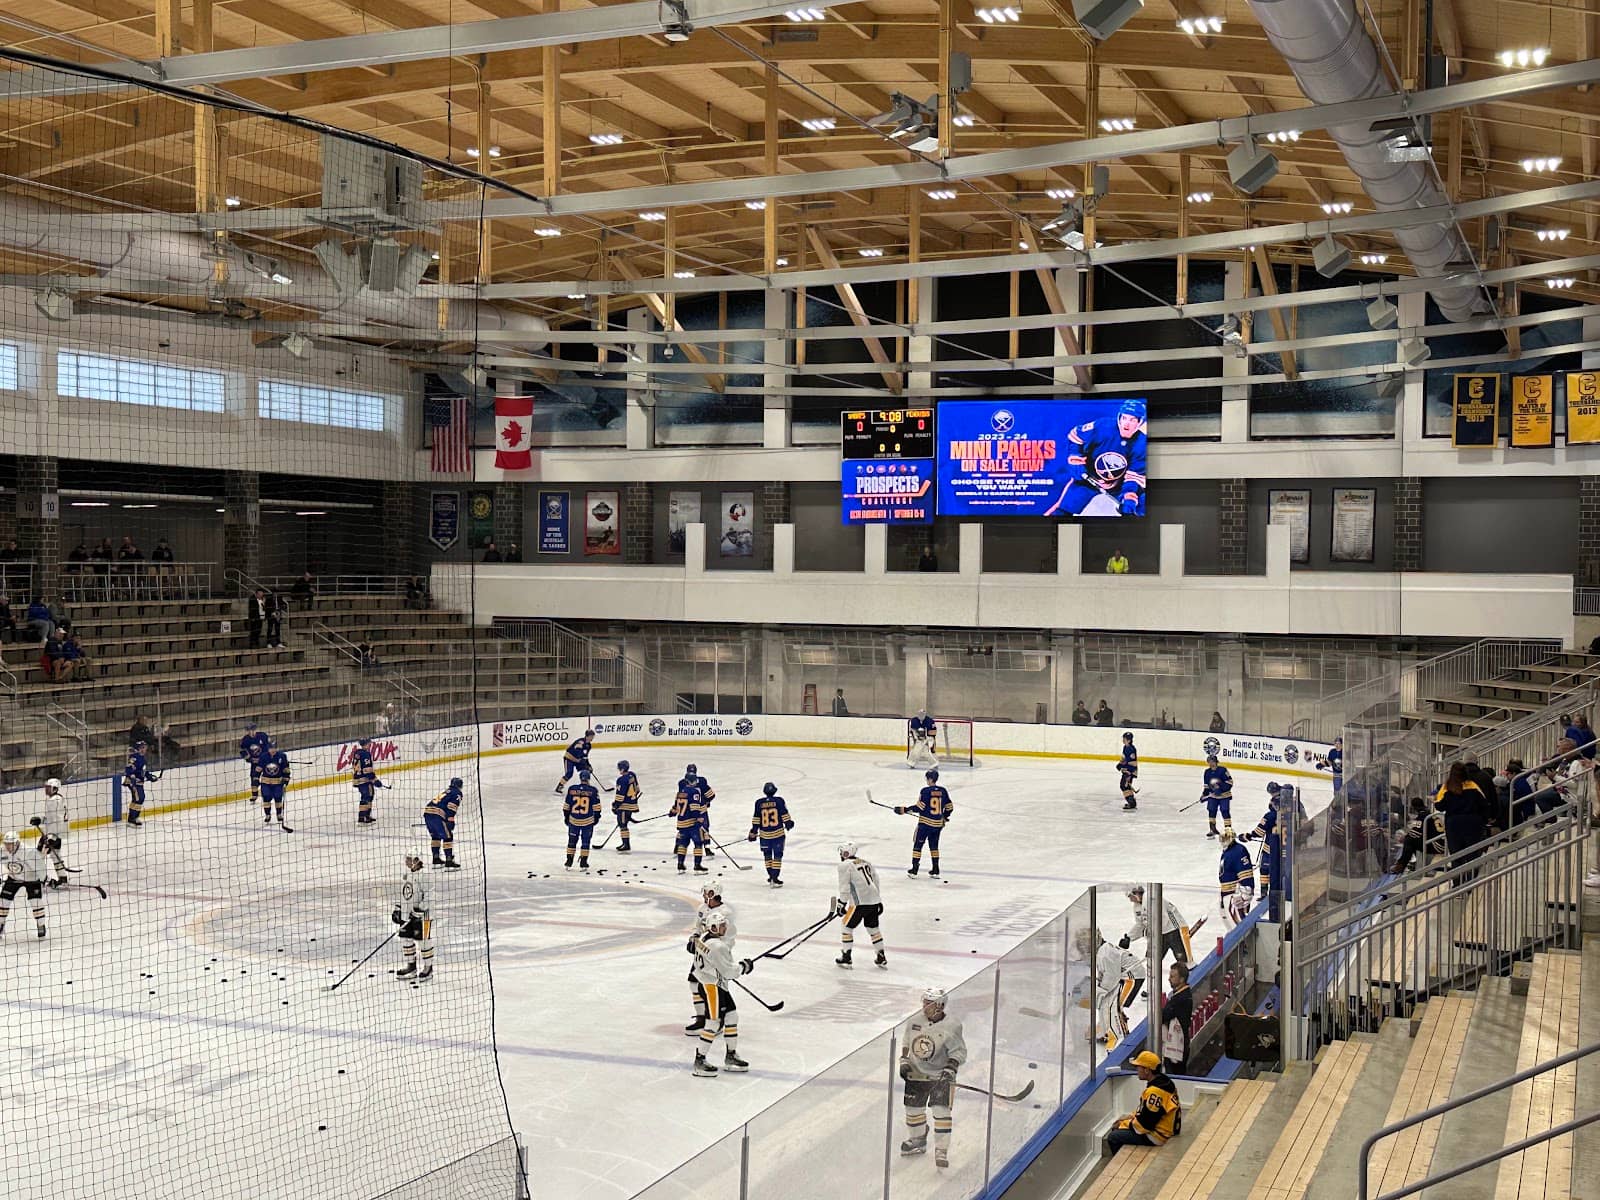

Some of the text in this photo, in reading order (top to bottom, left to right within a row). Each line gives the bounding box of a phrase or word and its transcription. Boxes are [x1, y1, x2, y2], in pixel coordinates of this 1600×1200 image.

[1577, 407, 1598, 415] 2013
[856, 421, 863, 432] 0
[918, 419, 925, 430] 0
[950, 440, 1056, 459] MINI PACKS
[961, 459, 1044, 471] ON SALE NOW!
[856, 475, 920, 493] PROSPECTS
[46, 501, 55, 512] 10
[505, 721, 569, 733] M P CAROLL
[604, 723, 643, 733] ICE HOCKEY
[678, 717, 723, 727] Home of the
[668, 727, 733, 736] Buffalo Jr. Sabres
[505, 731, 569, 745] HARDWOOD
[1233, 738, 1252, 749] Home
[1262, 741, 1274, 751] the
[1222, 748, 1283, 762] Buffalo Jr. Sabres
[571, 796, 590, 815] 29
[930, 797, 942, 815] 91
[761, 808, 779, 828] 83
